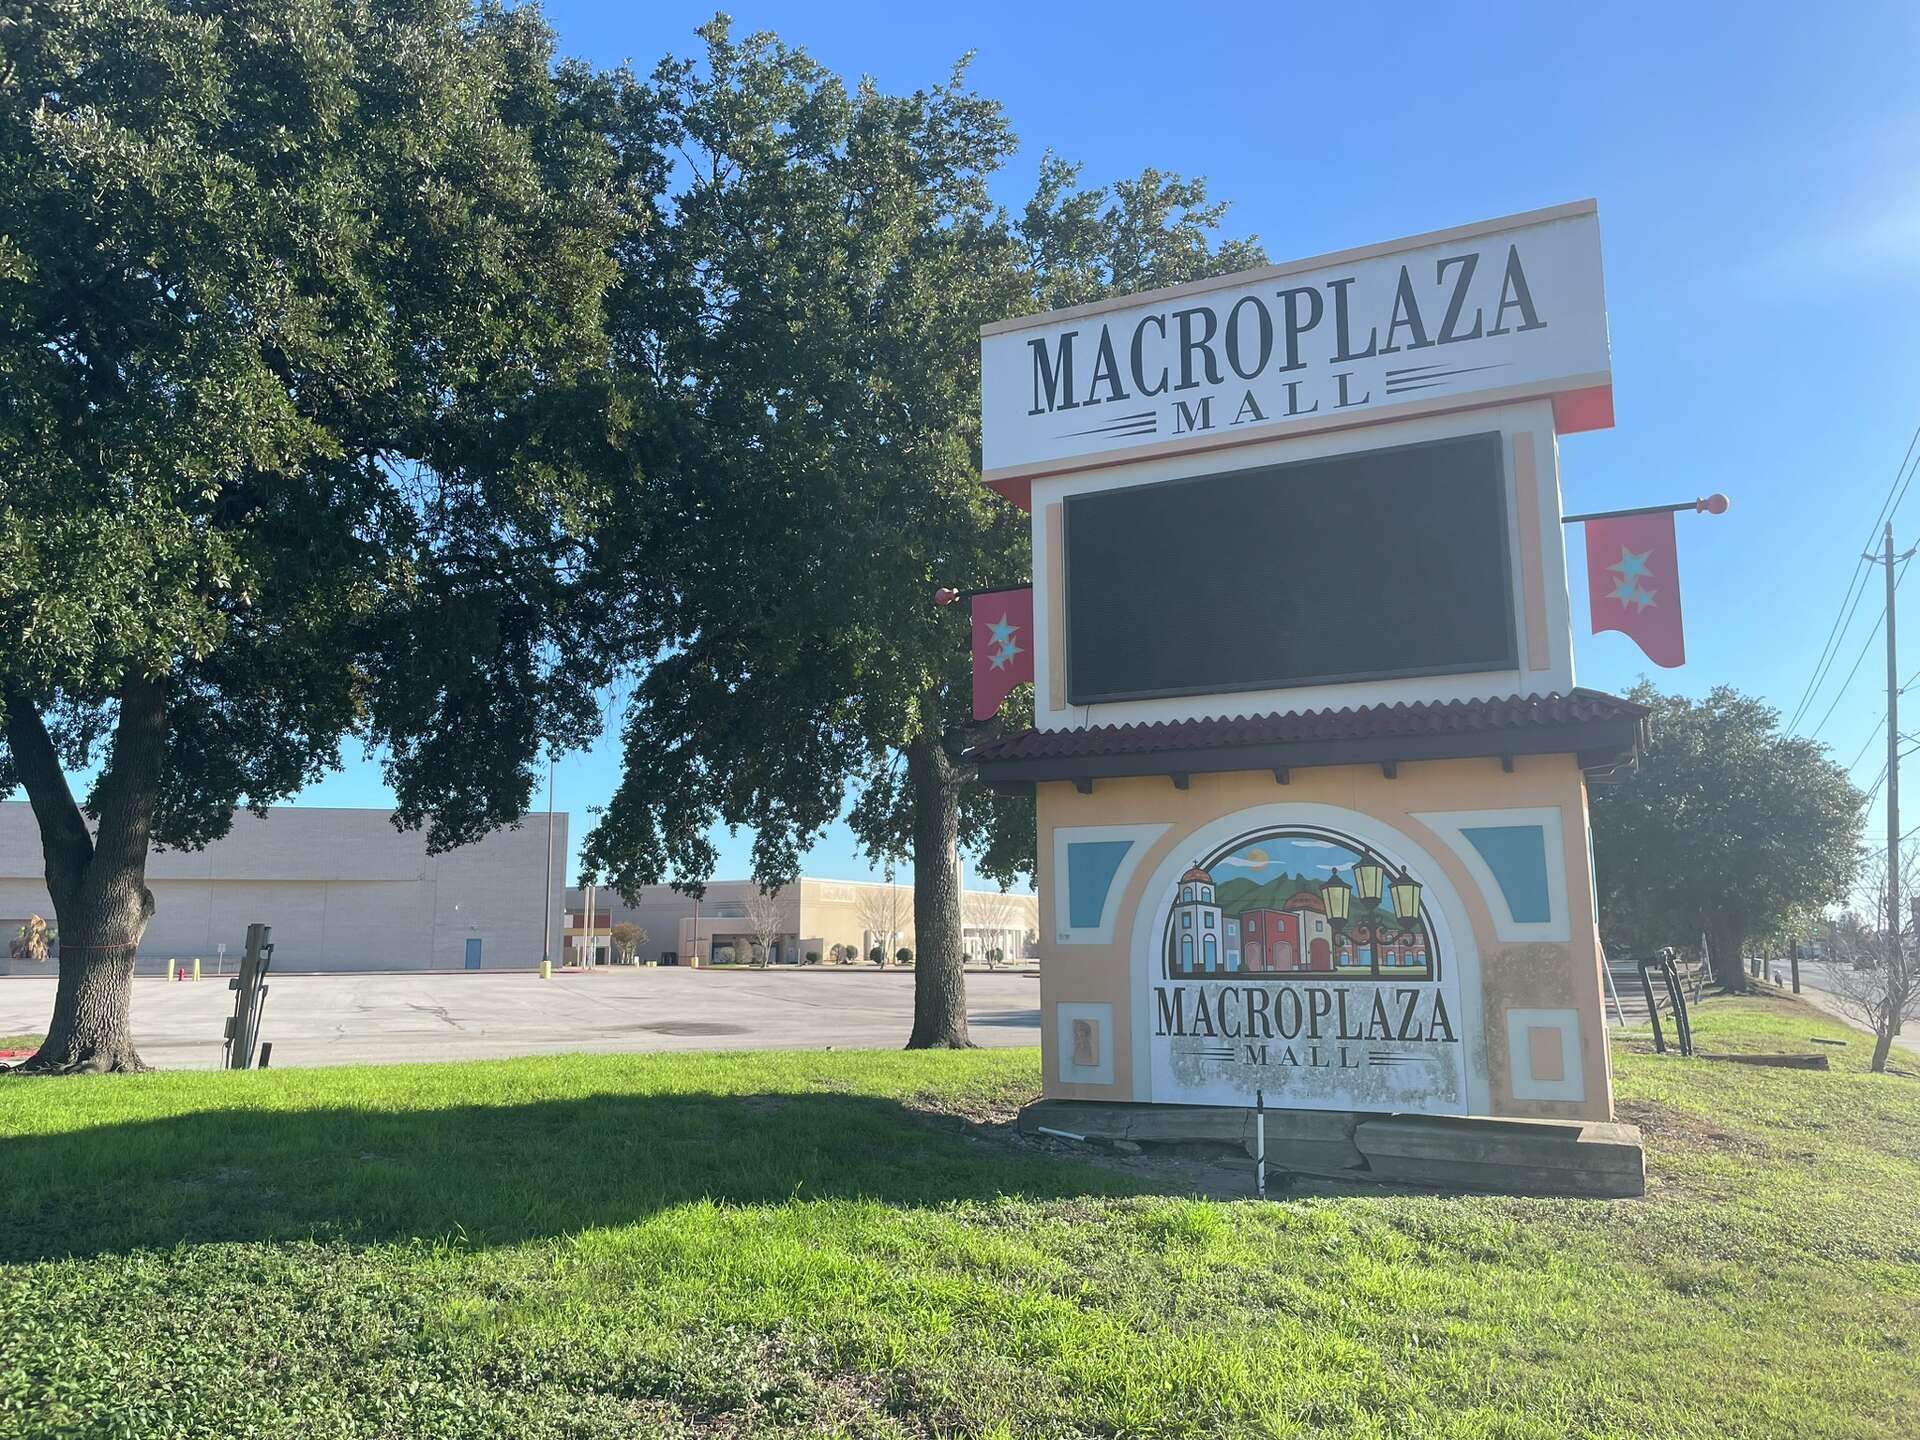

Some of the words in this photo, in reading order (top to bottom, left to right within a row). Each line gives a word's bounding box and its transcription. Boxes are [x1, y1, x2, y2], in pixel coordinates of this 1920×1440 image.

[1028, 244, 1547, 416] MACROPLAZA
[1172, 373, 1370, 434] MALL
[1154, 986, 1458, 1042] MACROPLAZA
[1246, 1045, 1359, 1068] MALL
